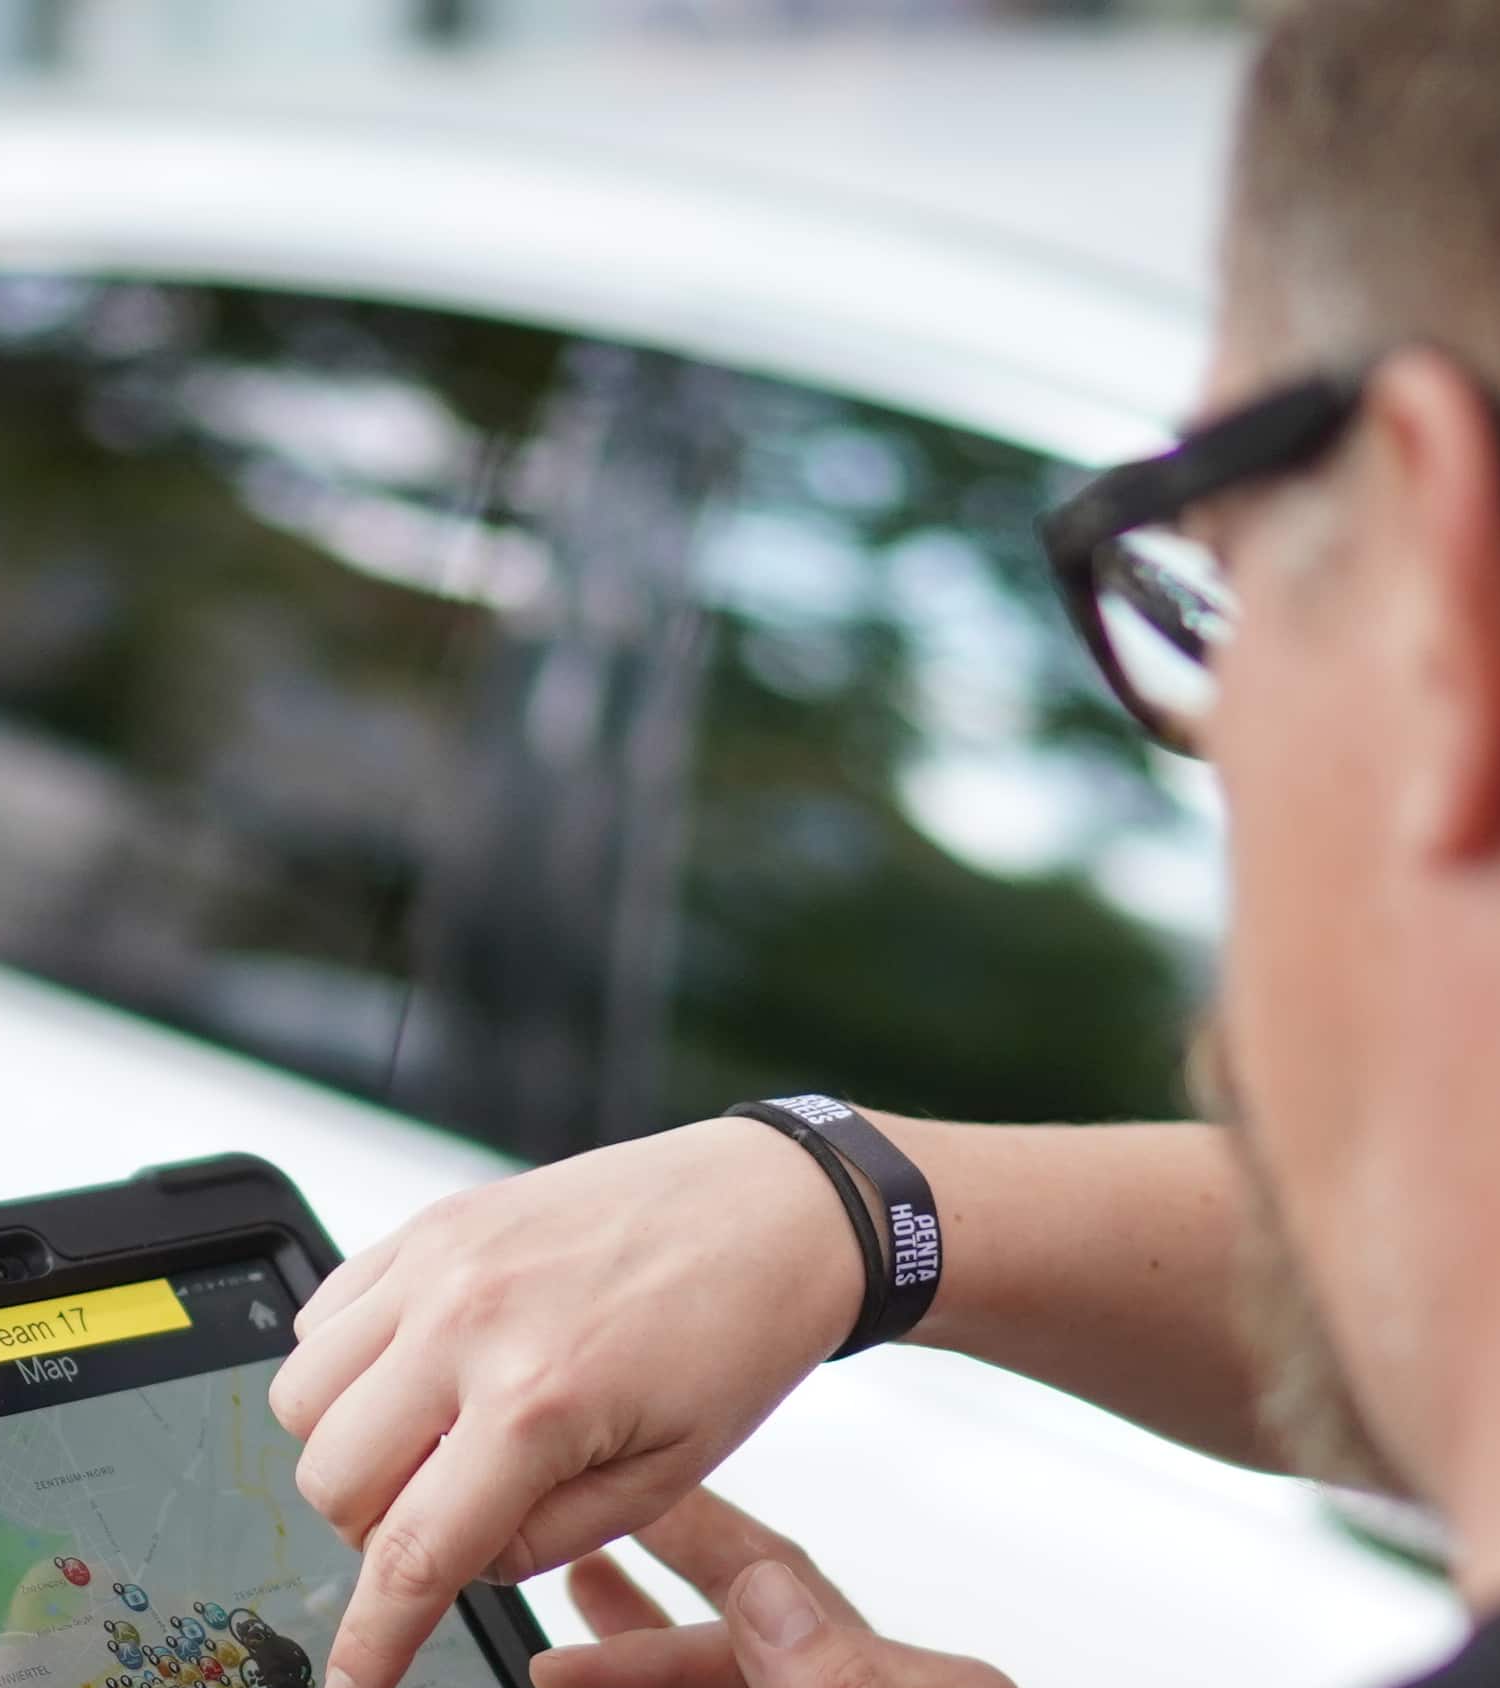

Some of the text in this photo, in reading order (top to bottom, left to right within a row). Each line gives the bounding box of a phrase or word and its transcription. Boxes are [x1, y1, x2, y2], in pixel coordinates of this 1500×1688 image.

[889, 1203, 918, 1286] HOTELS
[914, 1213, 940, 1282] PENTA
[57, 1306, 90, 1337] 17
[14, 1355, 79, 1386] Map
[33, 1465, 115, 1491] ZENTRUM-NORD
